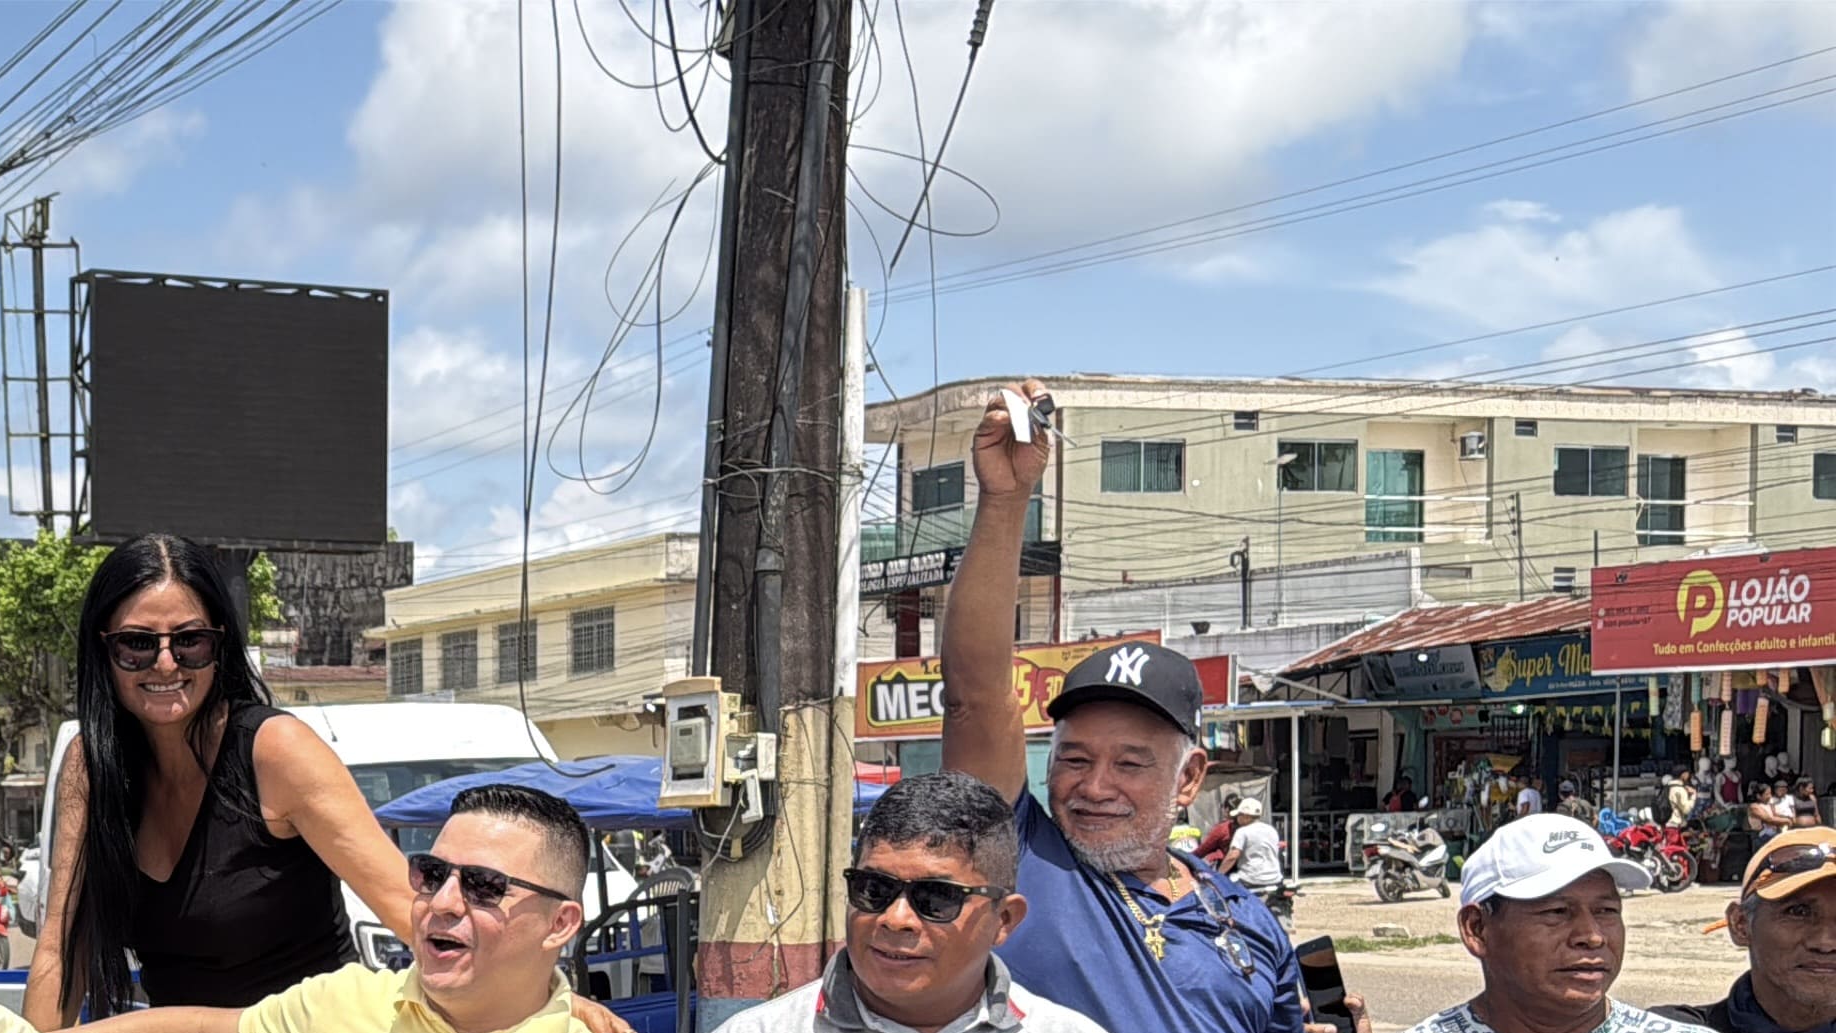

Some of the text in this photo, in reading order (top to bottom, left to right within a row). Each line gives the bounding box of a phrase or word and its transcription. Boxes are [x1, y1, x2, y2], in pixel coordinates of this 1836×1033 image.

[1728, 568, 1811, 608] LOJÃO
[1726, 602, 1812, 629] POPULAR
[1652, 642, 1677, 656] Tudo
[1679, 643, 1695, 654] em
[1696, 635, 1752, 656] Confecções
[1753, 635, 1787, 651] adulto
[1789, 638, 1797, 649] e
[1505, 644, 1555, 689] Super
